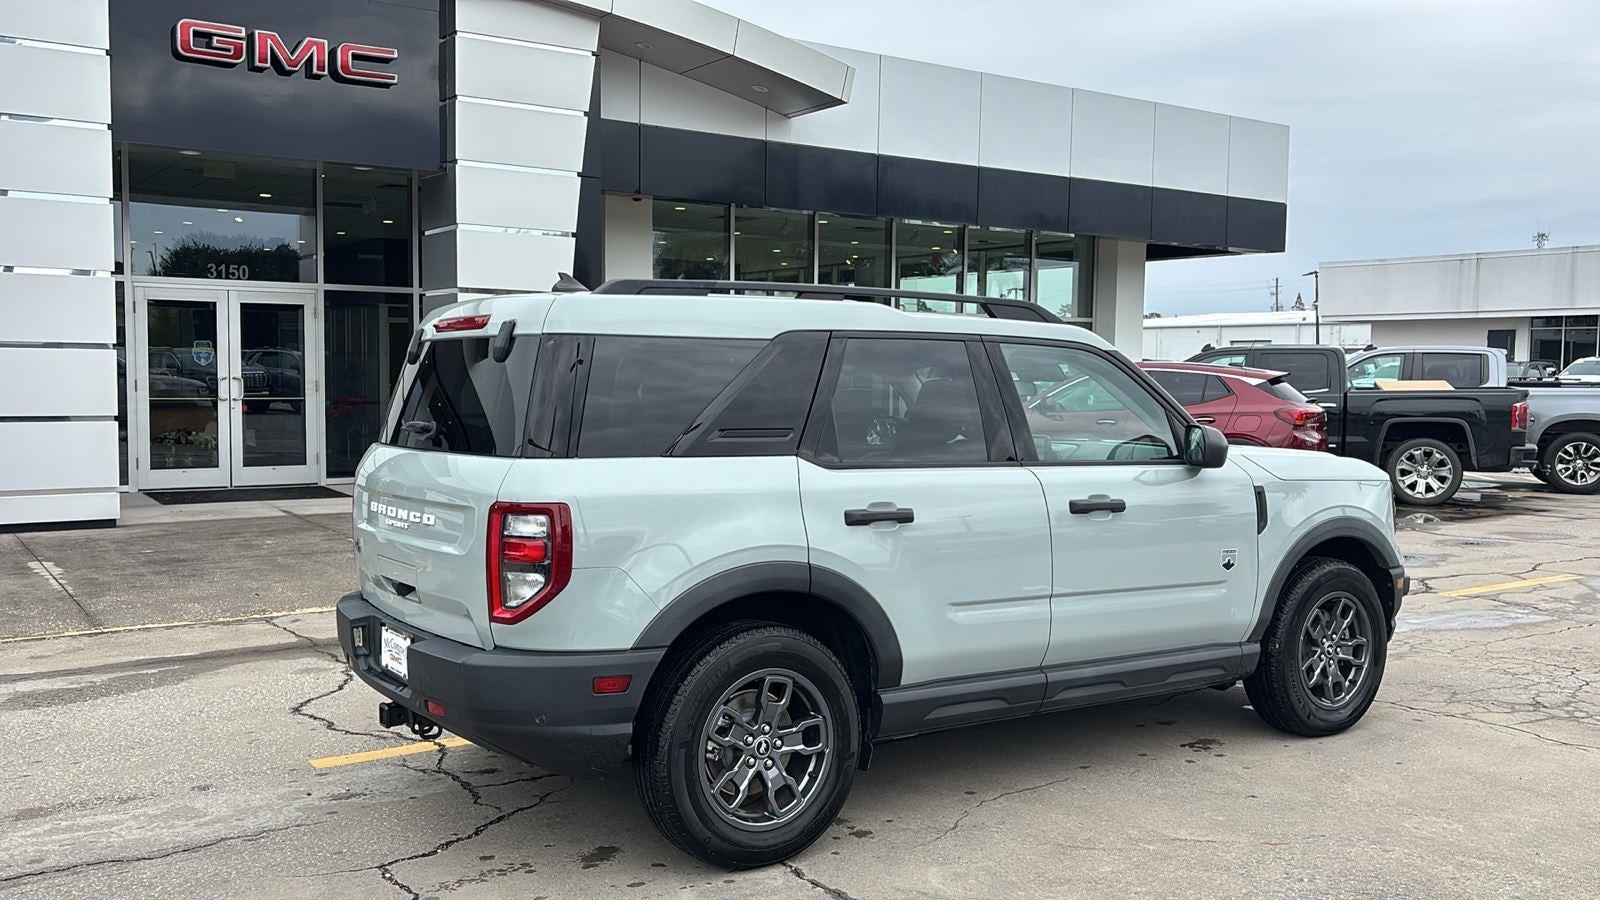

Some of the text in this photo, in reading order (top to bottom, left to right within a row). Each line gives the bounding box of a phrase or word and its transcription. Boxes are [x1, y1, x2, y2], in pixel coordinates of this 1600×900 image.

[173, 18, 399, 87] GMC
[206, 263, 249, 280] 3150
[370, 501, 436, 525] BRONCO
[385, 518, 409, 529] SPORT
